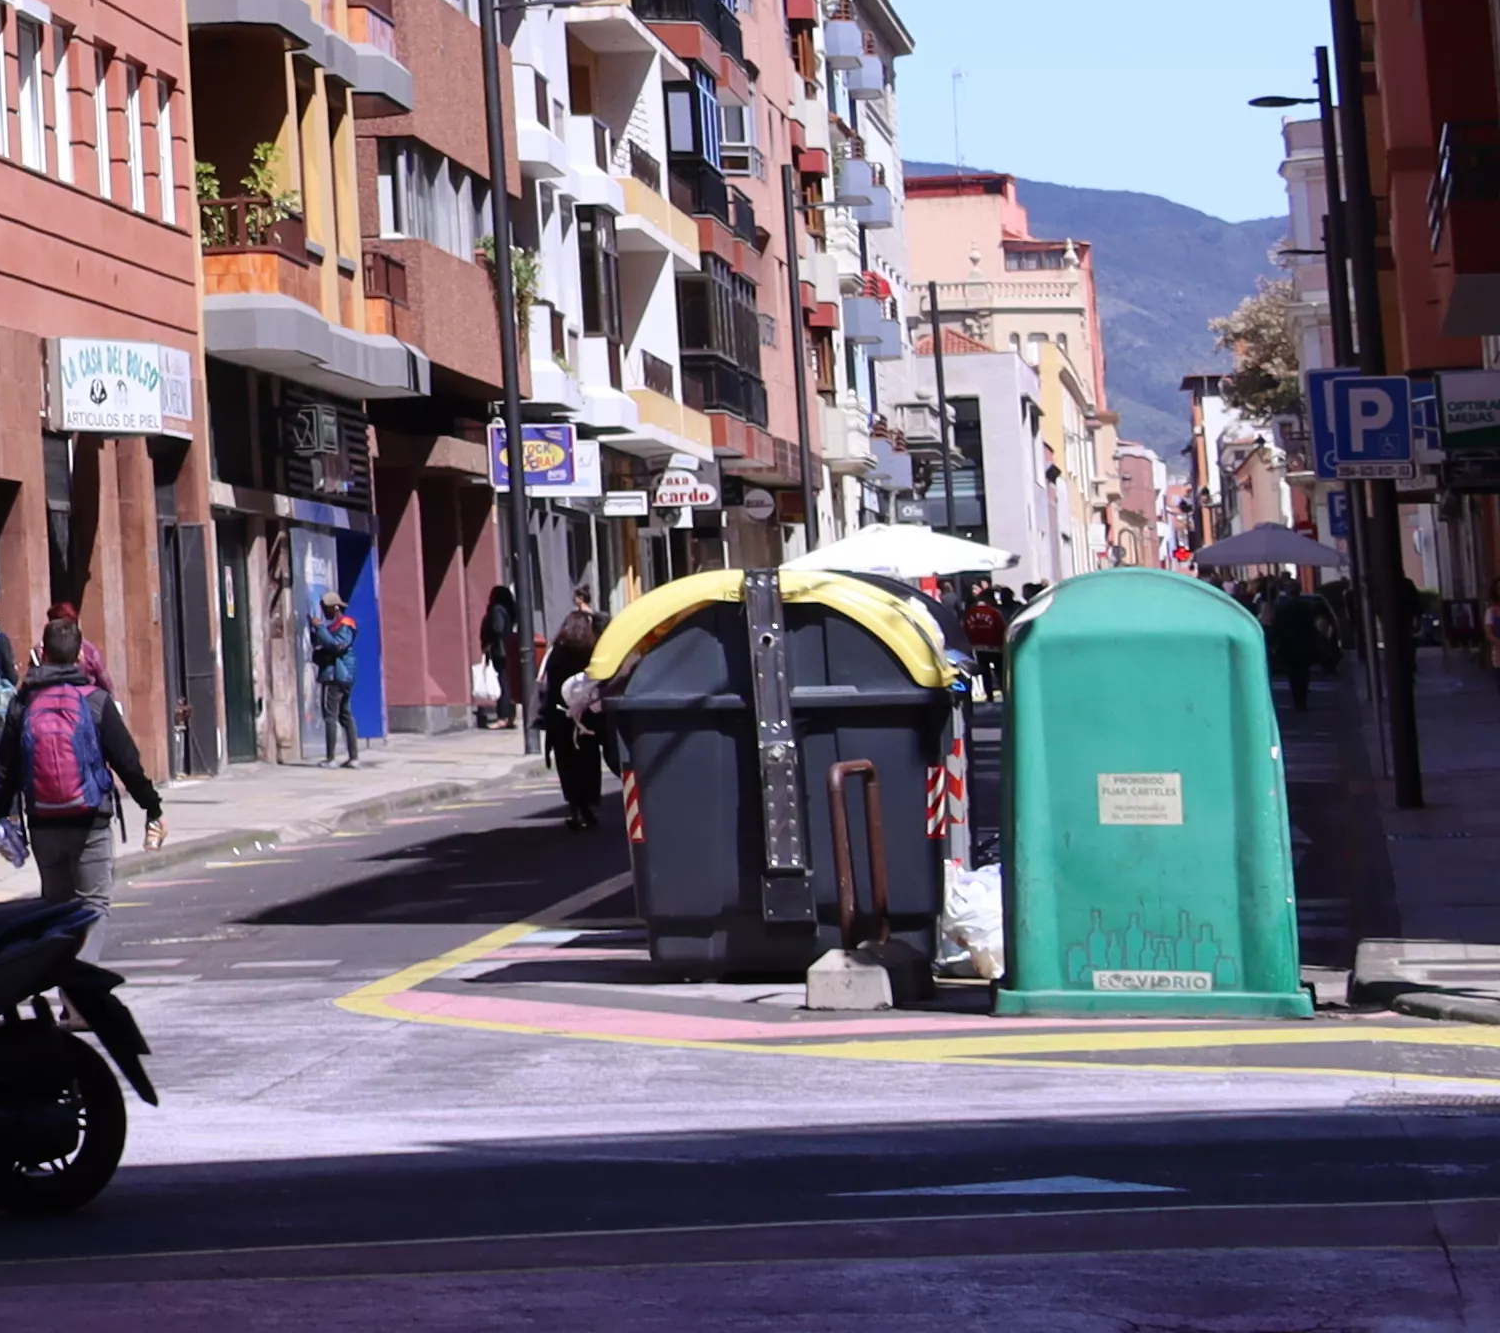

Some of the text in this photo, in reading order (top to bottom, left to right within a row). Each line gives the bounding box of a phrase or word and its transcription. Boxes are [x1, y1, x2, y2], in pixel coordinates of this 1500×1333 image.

[66, 412, 160, 429] ARTICULOS DE PIEL
[1348, 388, 1394, 452] P
[1098, 974, 1208, 990] ECOVIDRIO
